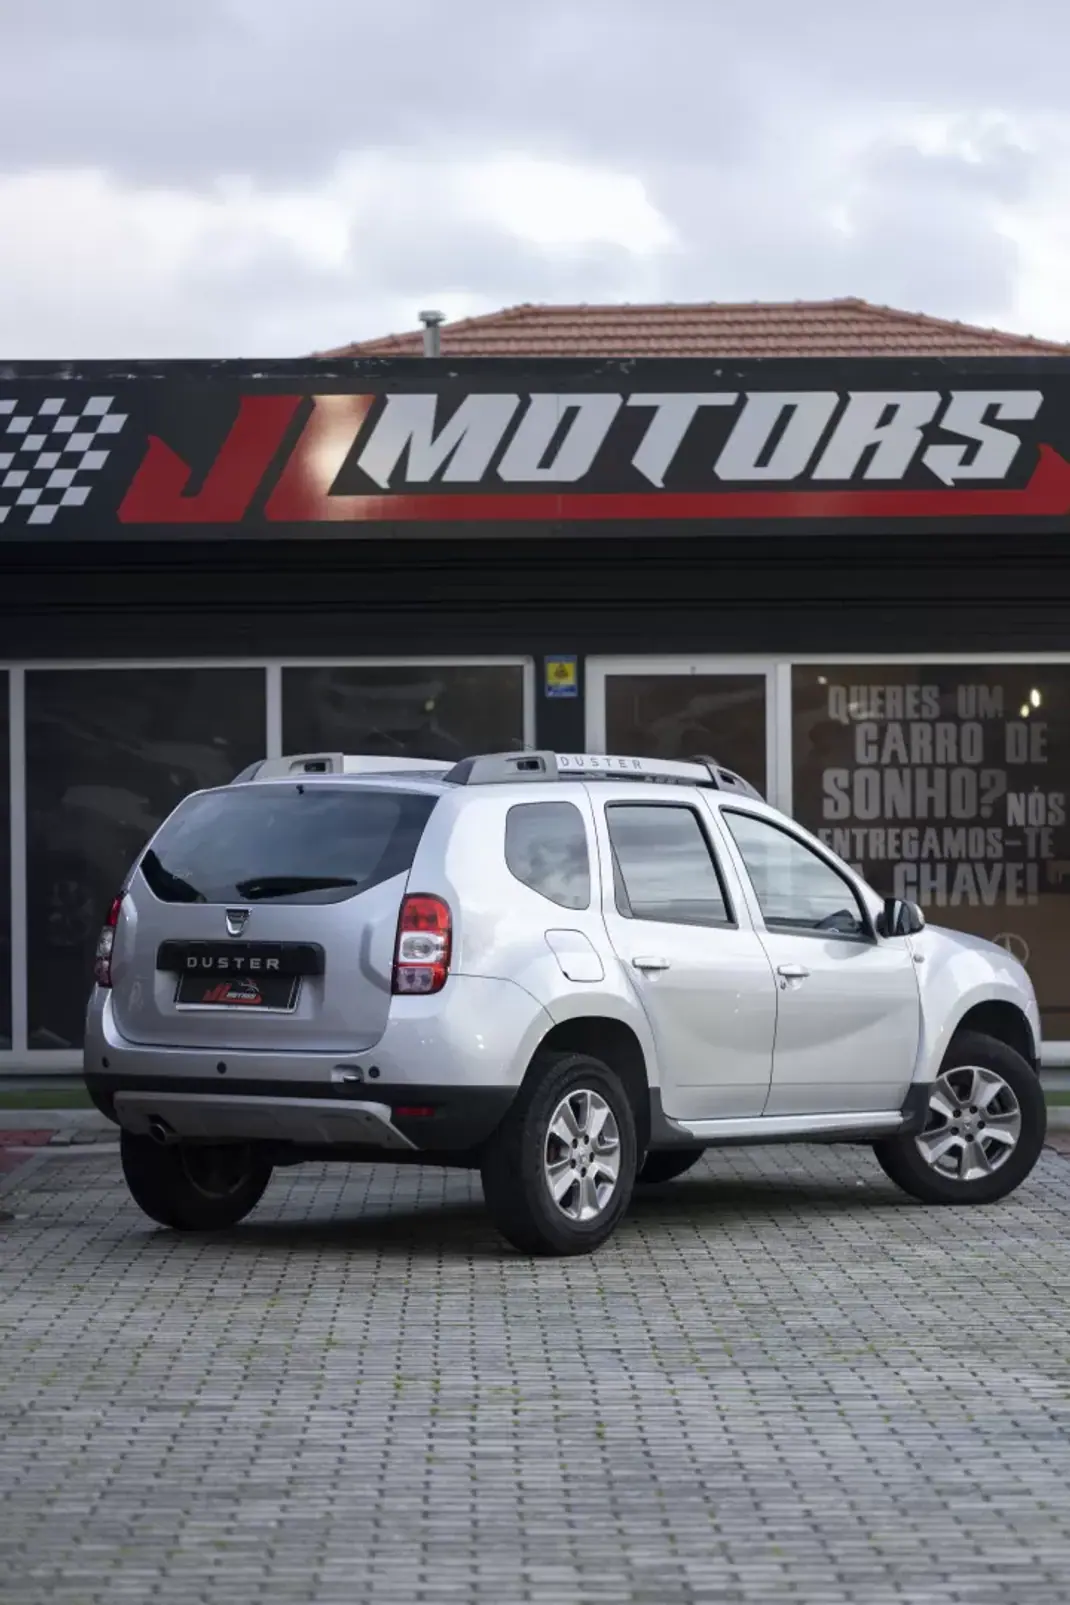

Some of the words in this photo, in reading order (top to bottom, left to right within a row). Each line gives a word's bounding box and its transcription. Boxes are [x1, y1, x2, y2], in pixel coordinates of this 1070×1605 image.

[356, 389, 1044, 489] MOTORS
[828, 685, 940, 724] QUERES
[957, 684, 1004, 719] UM
[560, 756, 642, 770] DUSTER
[855, 722, 984, 765] CARRO
[1005, 722, 1048, 764] DE
[822, 767, 1007, 820] SONHO?
[1007, 785, 1066, 827] NÓS
[893, 862, 1039, 907] CHAVE!
[187, 957, 280, 970] DUSTER
